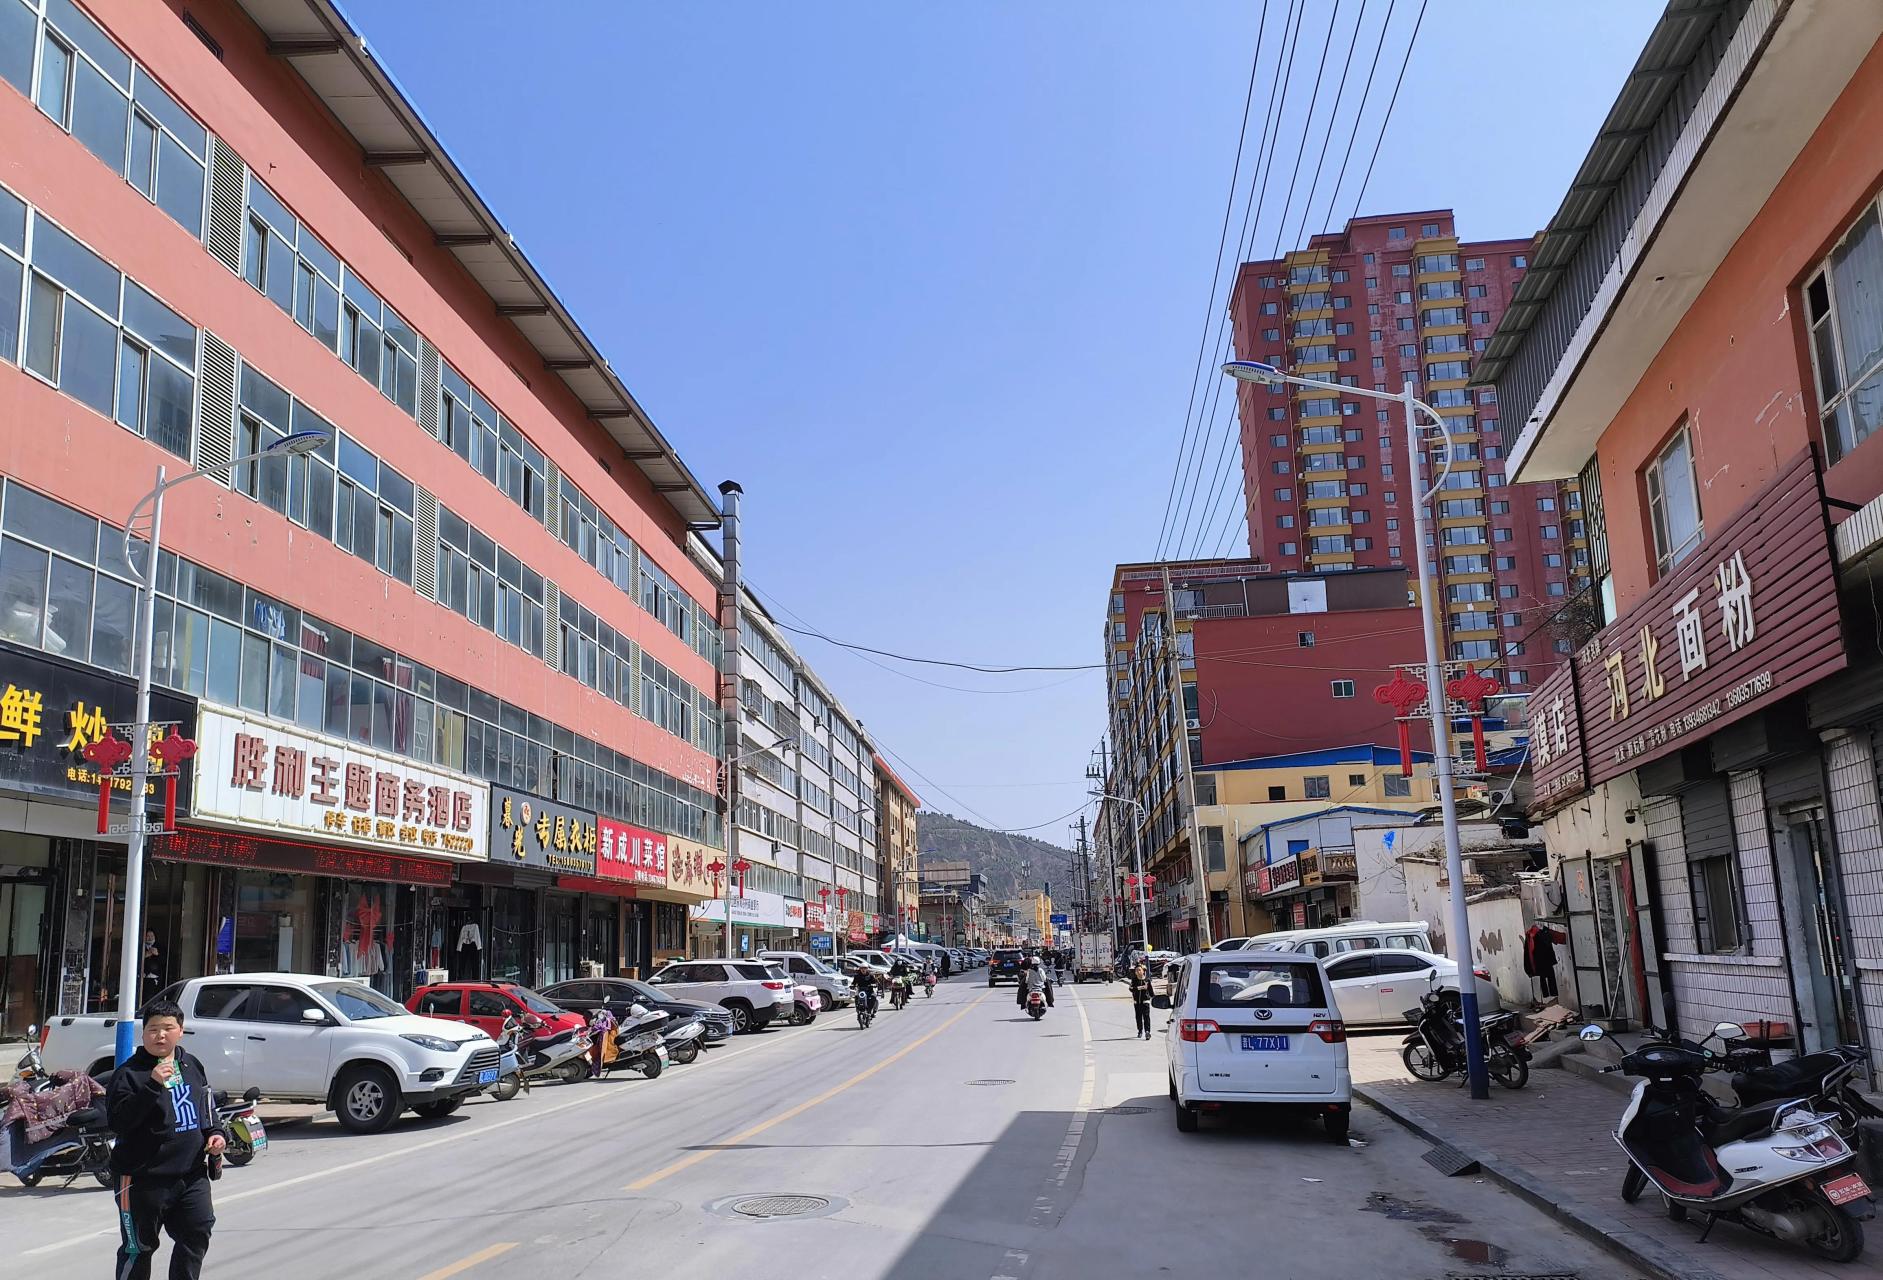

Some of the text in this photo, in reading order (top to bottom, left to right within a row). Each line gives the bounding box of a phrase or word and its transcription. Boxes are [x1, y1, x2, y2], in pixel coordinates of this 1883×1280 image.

[1604, 549, 1758, 721] 河北面粉
[1726, 671, 1772, 708] 13603577699
[232, 733, 472, 831] 胜利主题商务酒店
[537, 811, 597, 855] 专属衣柜
[601, 827, 665, 870] 新成川菜馆
